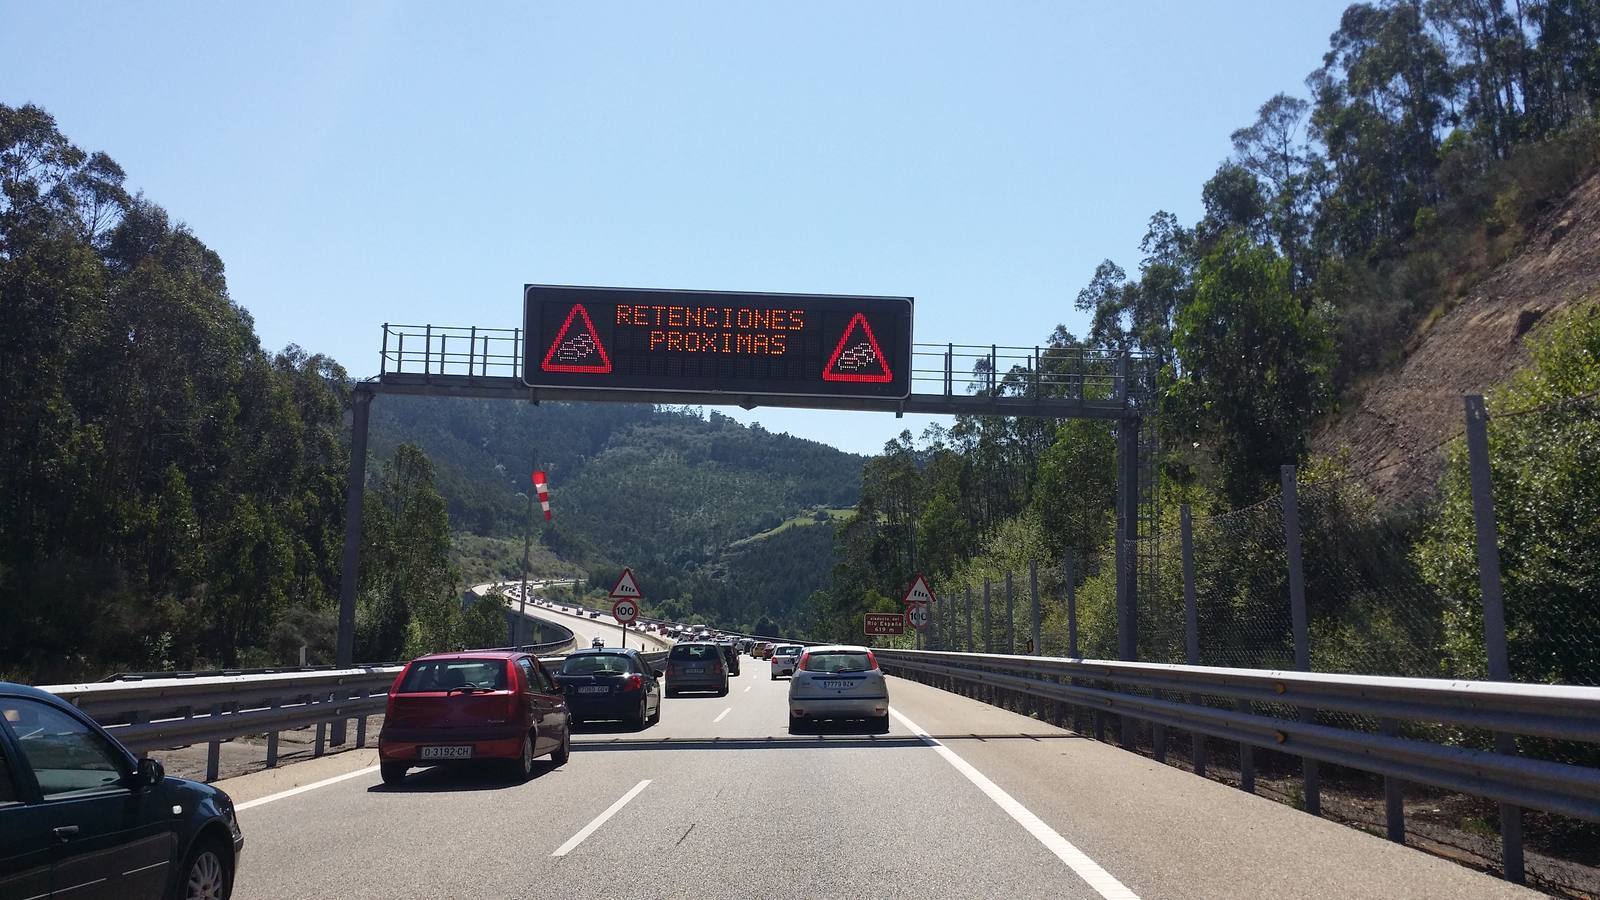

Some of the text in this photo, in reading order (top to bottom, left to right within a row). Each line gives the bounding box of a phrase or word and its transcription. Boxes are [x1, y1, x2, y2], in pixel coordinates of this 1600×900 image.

[616, 304, 805, 331] RETENCIONES
[649, 331, 786, 355] PROXIMAS
[617, 606, 634, 616] 100
[910, 612, 927, 621] 100
